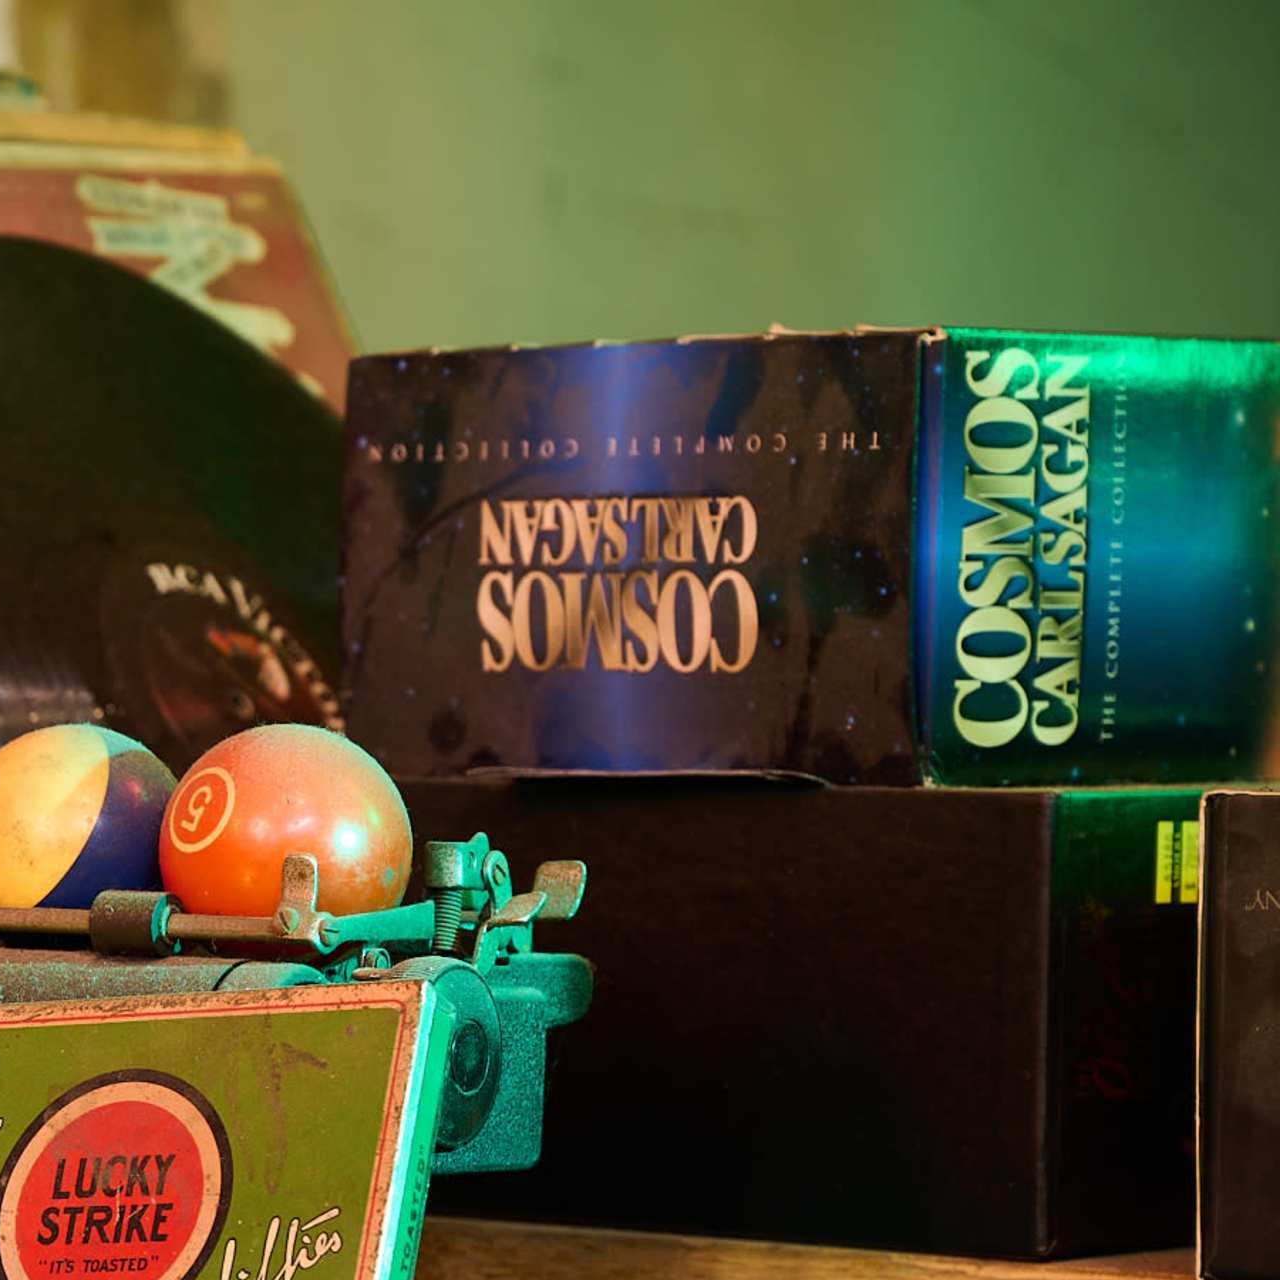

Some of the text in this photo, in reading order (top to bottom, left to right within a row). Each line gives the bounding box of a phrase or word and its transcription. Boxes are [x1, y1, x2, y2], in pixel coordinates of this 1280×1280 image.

[368, 430, 881, 463] THE COMPLETE COLLECTION
[478, 495, 758, 566] CARL SAGAN
[953, 346, 1040, 749] COSMOS
[1030, 353, 1092, 747] CARL SAGAN
[1098, 352, 1129, 744] THE COMPLETE COLLECTION
[476, 569, 759, 674] COSMOS
[181, 785, 213, 833] 5
[51, 1154, 177, 1200] LUCKY
[36, 1203, 175, 1246] STRIKE
